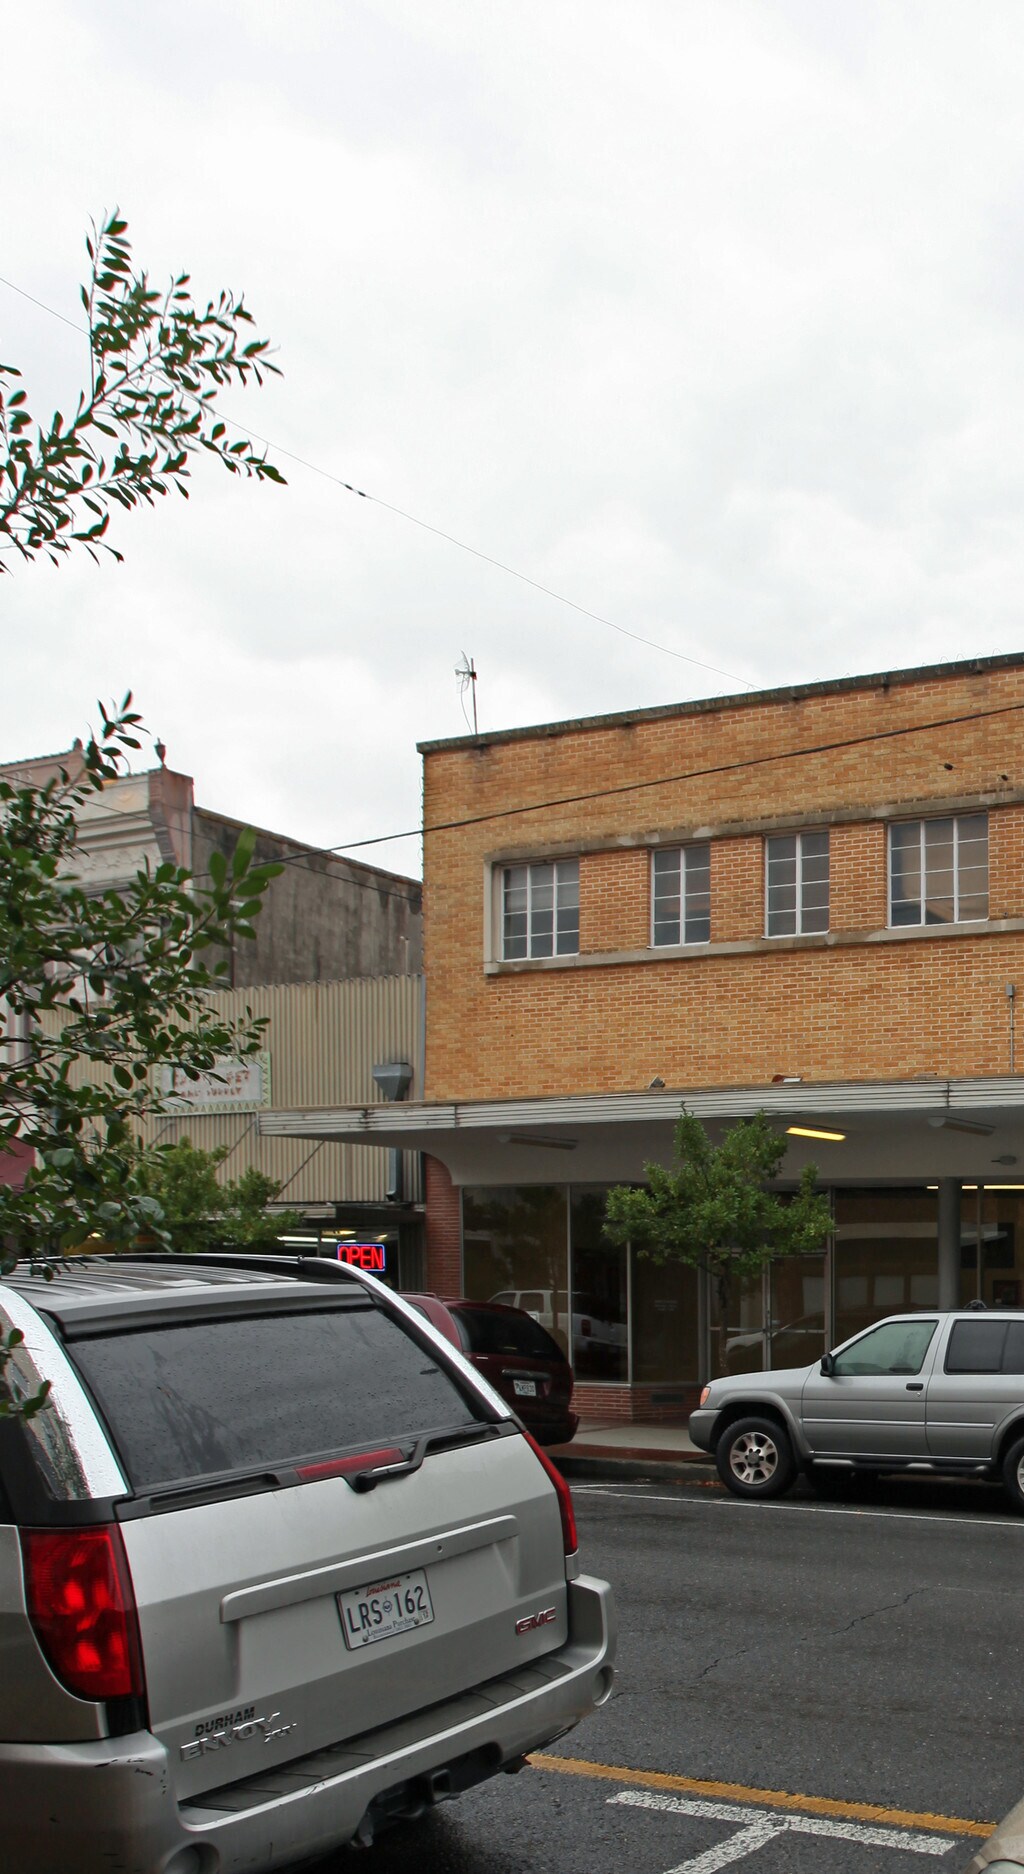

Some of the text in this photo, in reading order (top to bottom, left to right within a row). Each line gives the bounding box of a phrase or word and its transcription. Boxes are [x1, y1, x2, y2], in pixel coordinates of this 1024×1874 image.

[339, 1245, 384, 1269] OPEN
[346, 1598, 383, 1633] LRS
[393, 1585, 427, 1618] 162
[515, 1606, 557, 1636] GMC
[180, 1711, 281, 1761] ENVOY
[195, 1706, 255, 1737] DURHAM
